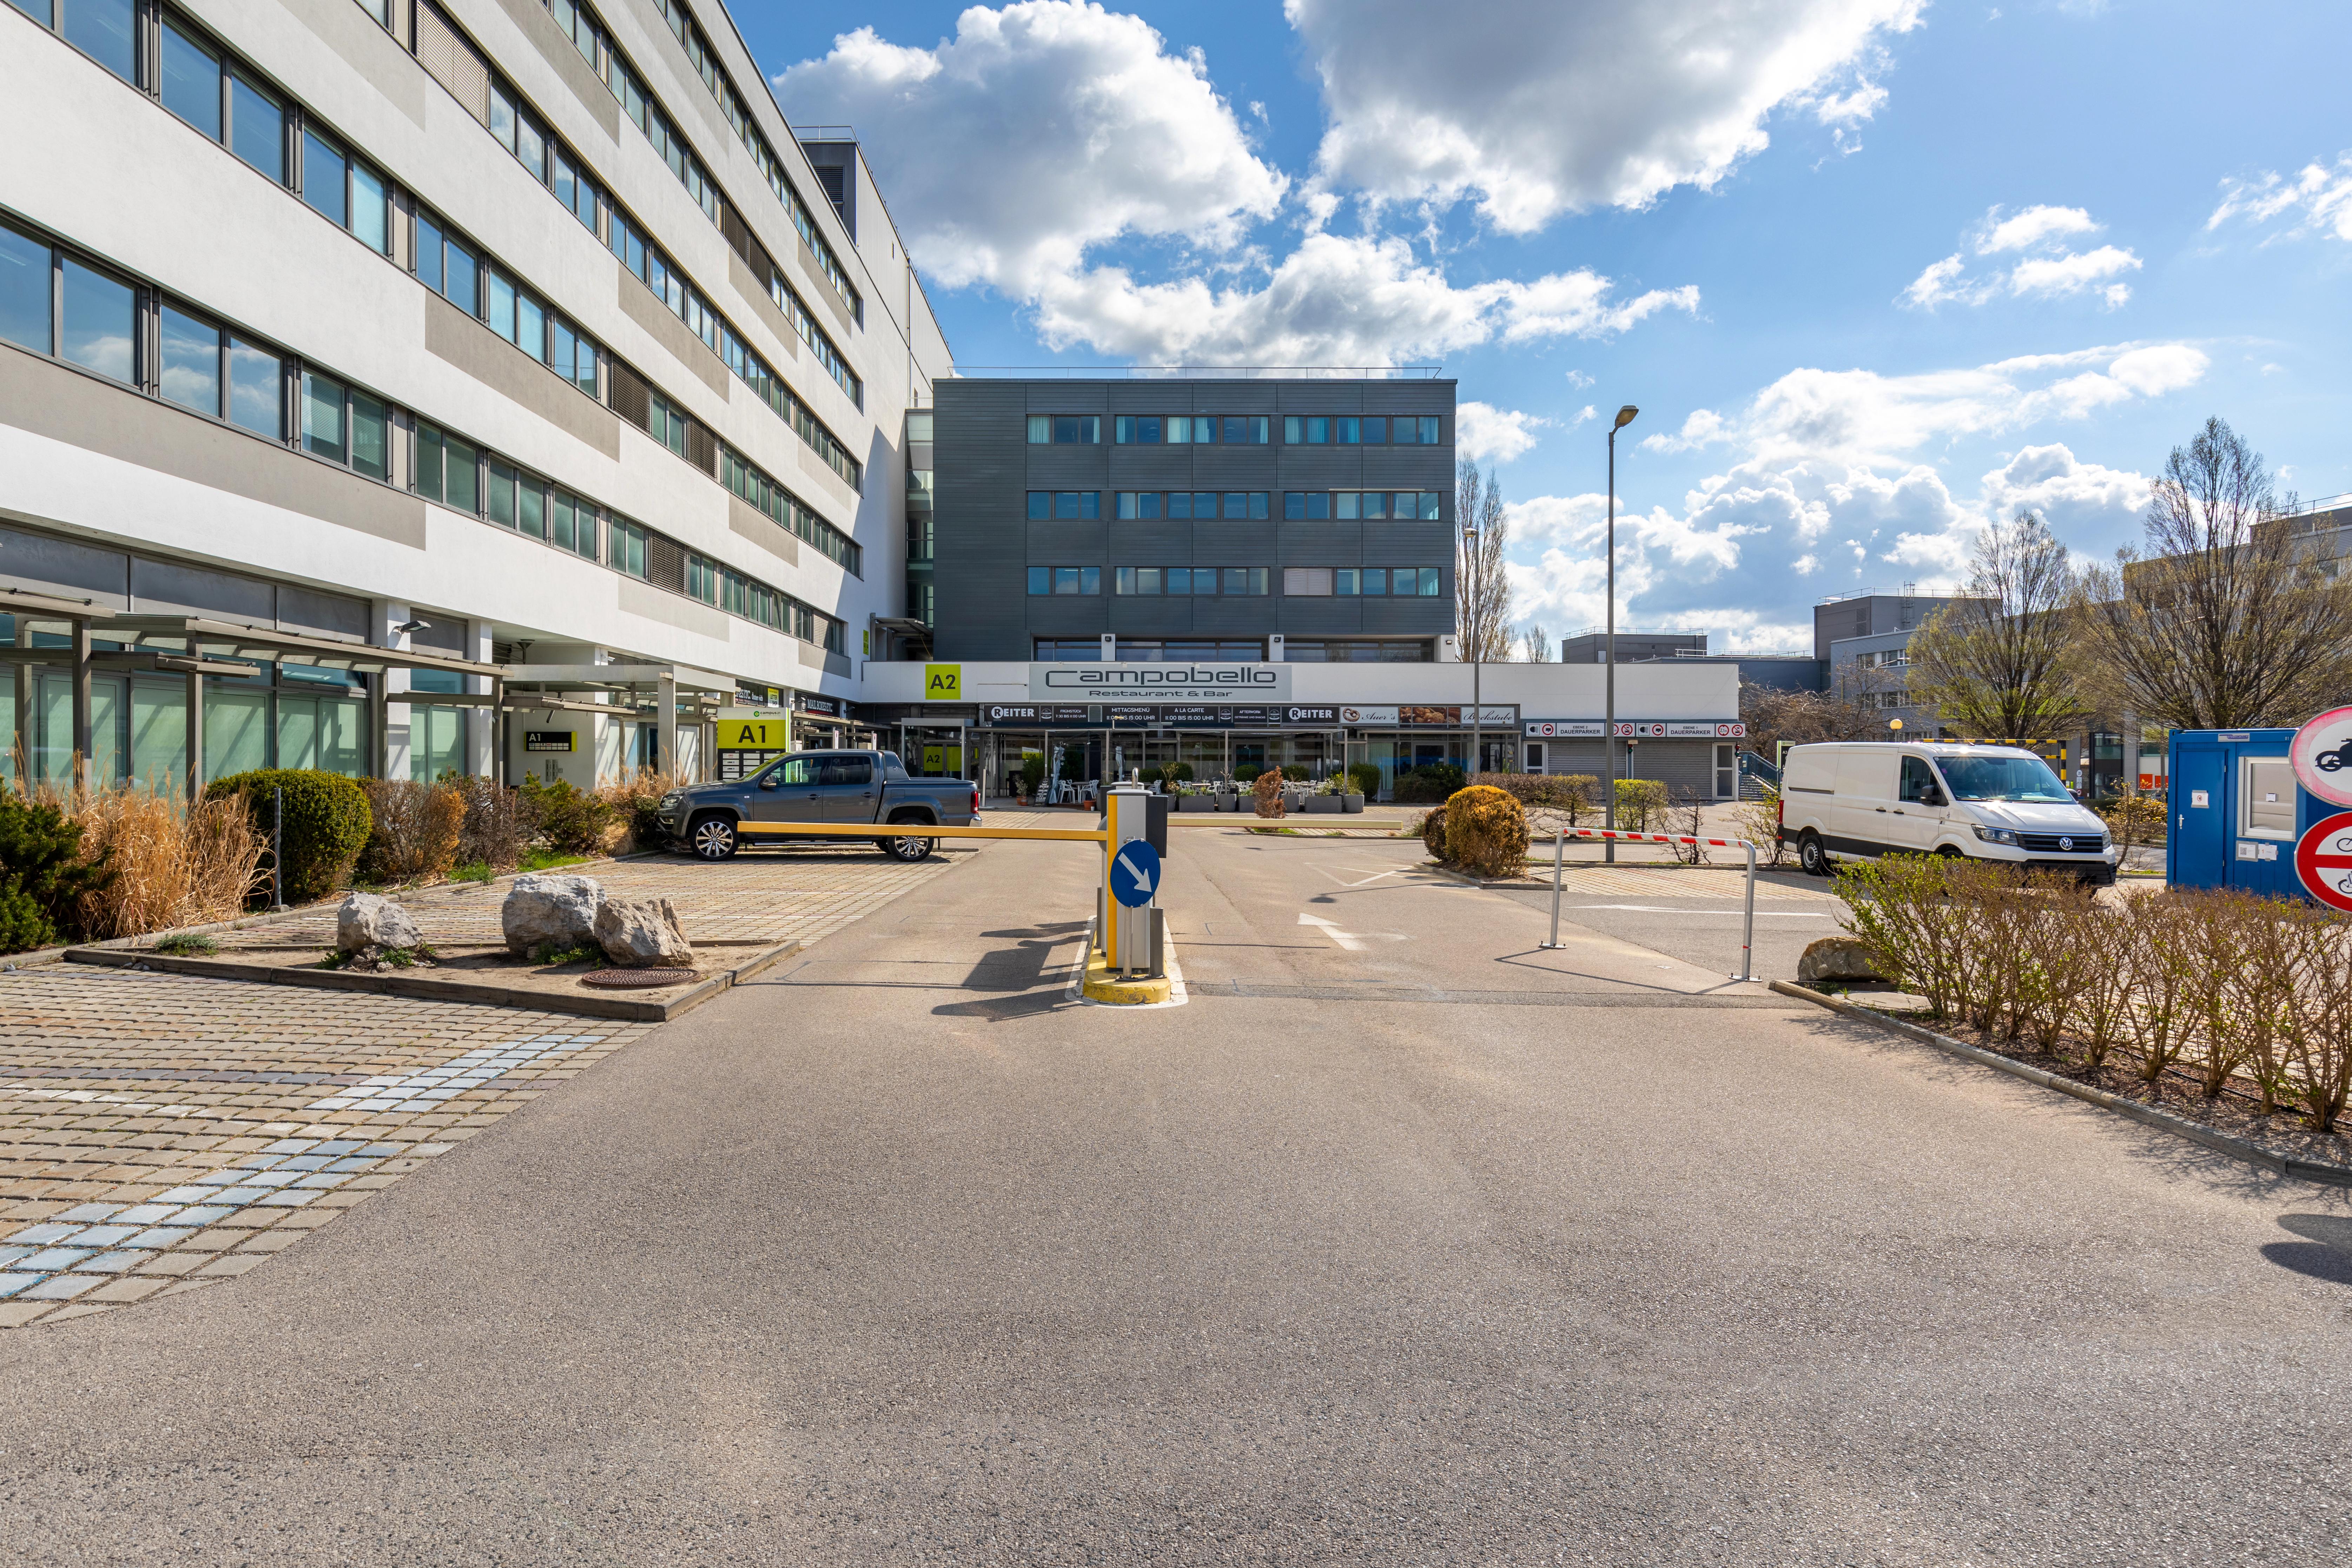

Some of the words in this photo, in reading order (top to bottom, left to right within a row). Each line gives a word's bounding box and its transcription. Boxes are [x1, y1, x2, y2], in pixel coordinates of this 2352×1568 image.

[930, 674, 956, 689] A2
[1046, 667, 1276, 688] campobello
[807, 699, 817, 710] MAIL
[817, 701, 826, 711] BOXES
[993, 708, 1035, 717] REITER
[1291, 709, 1333, 718] REITER
[1464, 710, 1512, 720] Bckstube
[529, 733, 541, 741] A1
[738, 725, 766, 743] A1
[926, 755, 940, 763] A2
